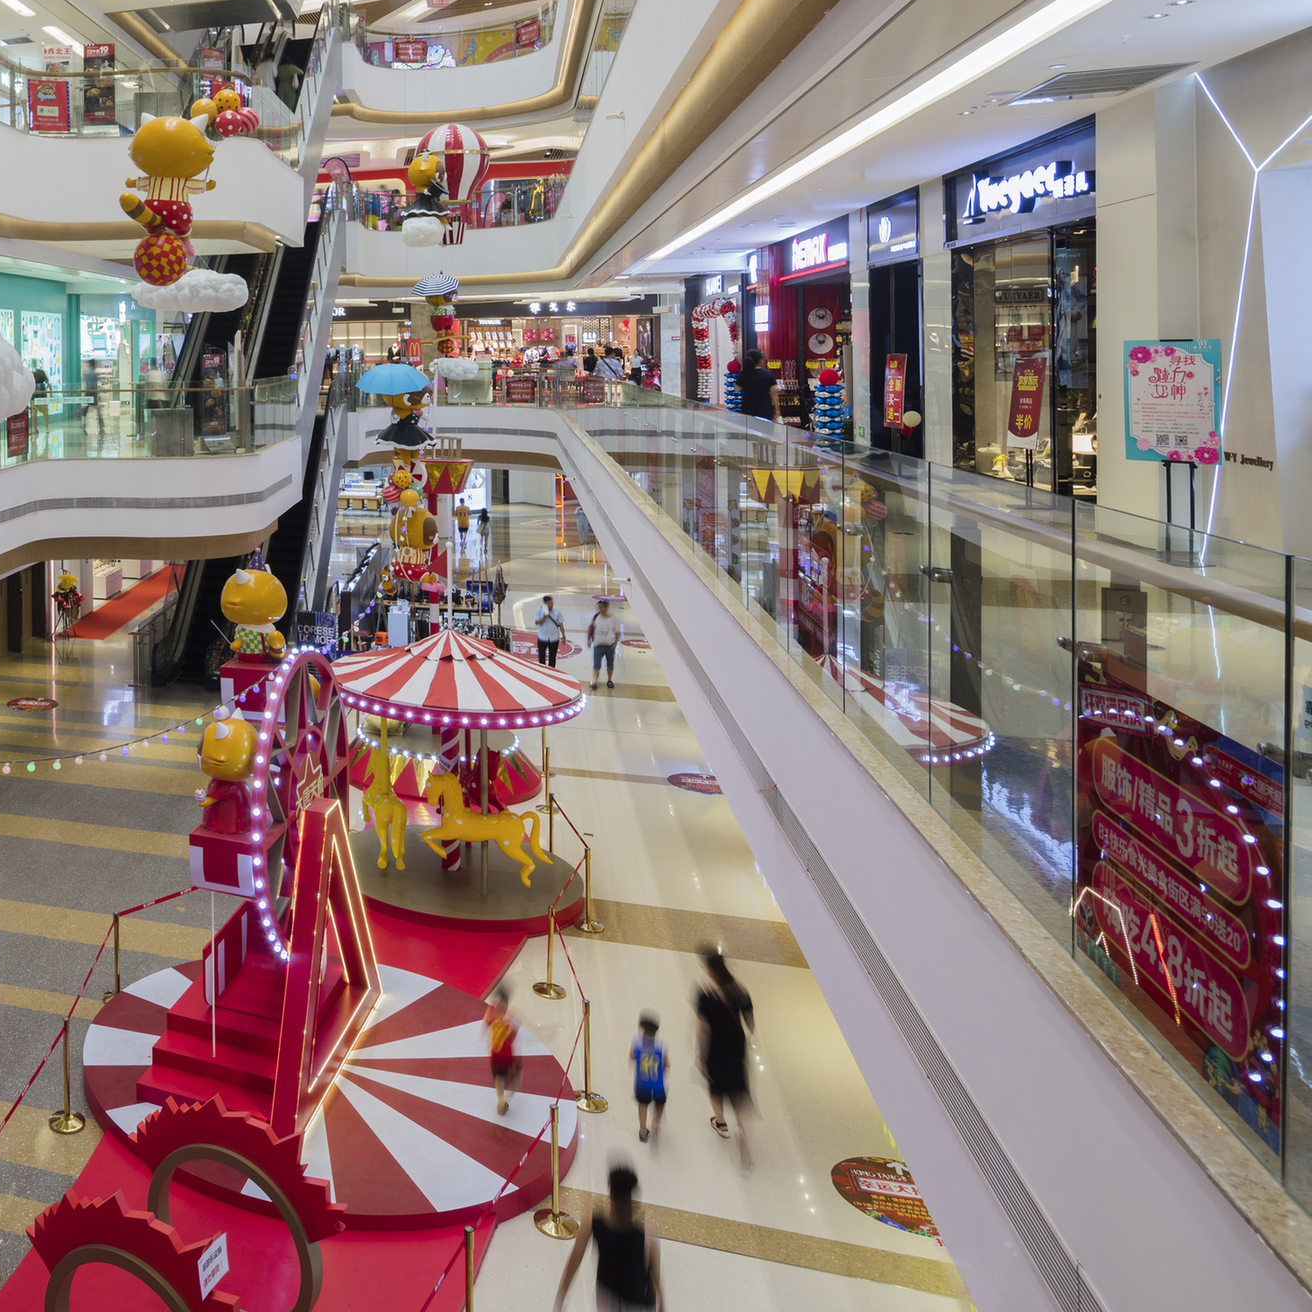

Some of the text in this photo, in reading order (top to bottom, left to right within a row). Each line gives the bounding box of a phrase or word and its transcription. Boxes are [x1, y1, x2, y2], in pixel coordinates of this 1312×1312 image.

[1169, 356, 1196, 366] 寻找
[1148, 367, 1187, 384] 魅力
[1150, 384, 1187, 402] 女神
[1015, 413, 1033, 430] 半价
[1240, 454, 1273, 471] Jewellery
[297, 624, 335, 636] CORESE
[1084, 692, 1143, 728] 狂欢满月庆
[1101, 753, 1239, 883] 服饰/精品3折起
[1098, 822, 1241, 952] B1快乐食光美食街区满50送20
[1103, 885, 1233, 1043] 嗨吃4.8折起
